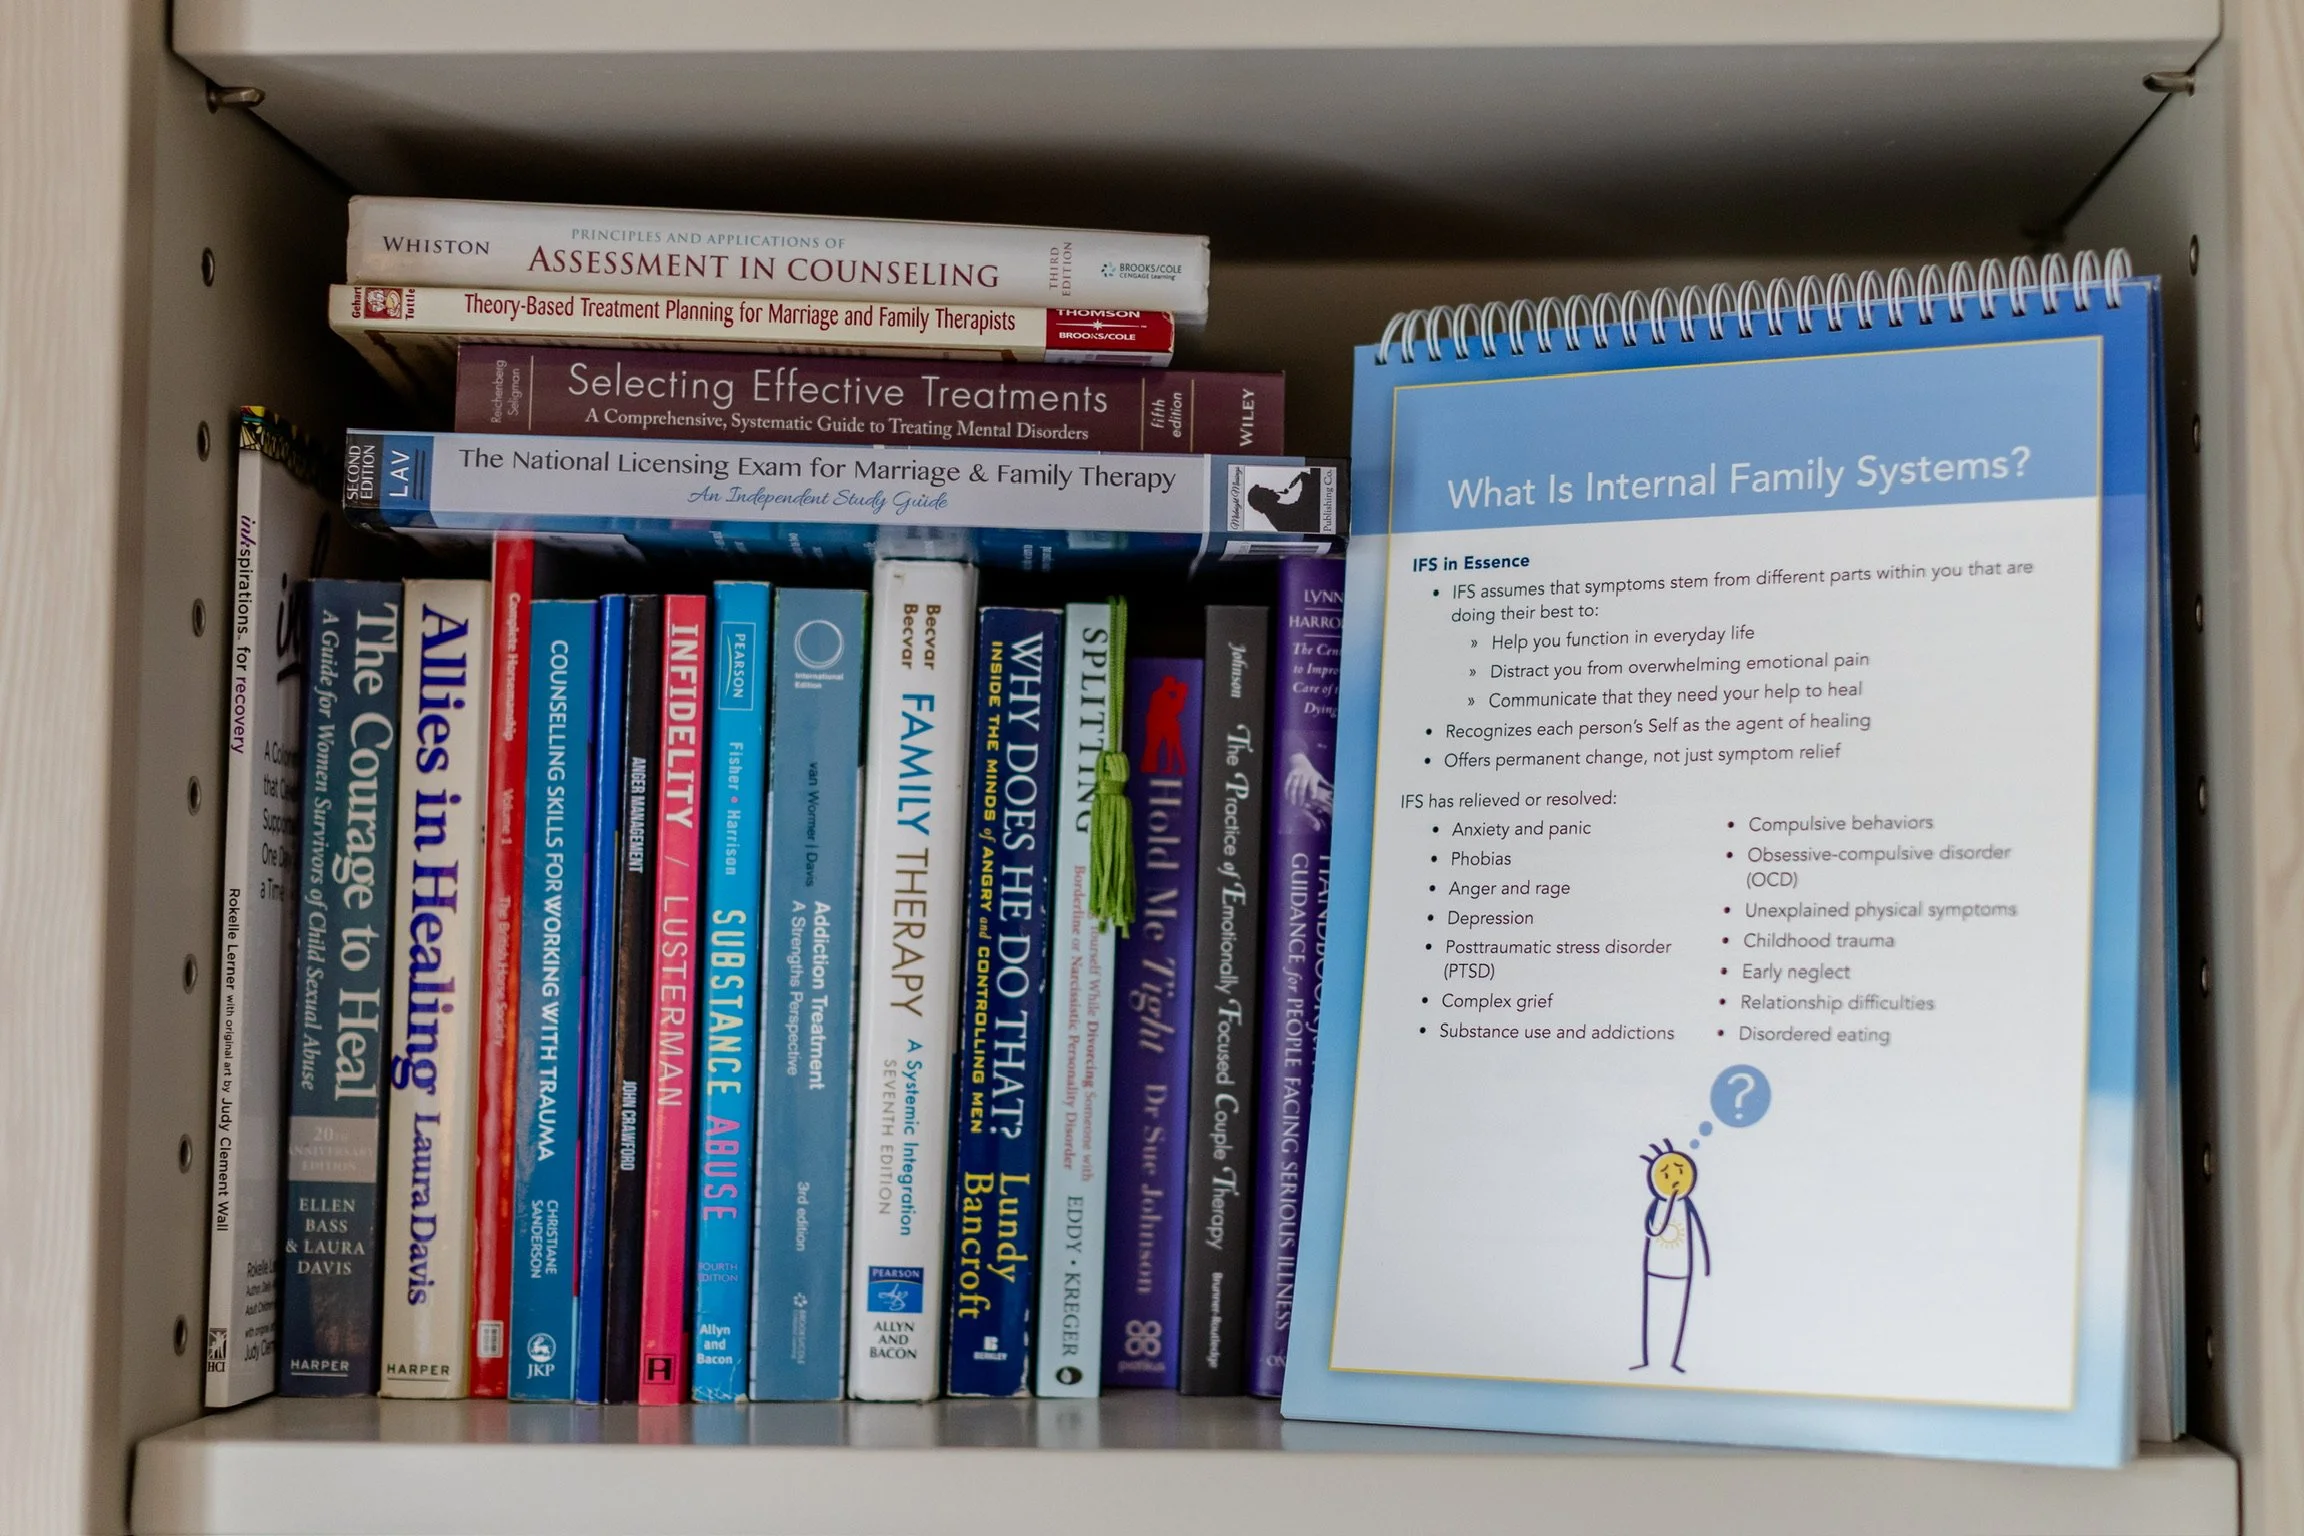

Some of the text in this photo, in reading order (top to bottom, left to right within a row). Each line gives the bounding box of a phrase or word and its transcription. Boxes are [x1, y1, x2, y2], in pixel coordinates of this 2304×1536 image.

[382, 235, 490, 256] WHISTON
[570, 227, 846, 250] PRINCIPLES AND APPLICATIONS OF
[527, 244, 999, 289] ASSESSMENT IN COUNSELING
[1048, 246, 1060, 290] THIRD
[1061, 241, 1073, 298] EDITION
[1118, 261, 1183, 275] BROOKS/COLE
[351, 286, 362, 319] Gehart
[405, 287, 417, 320] Tuttle
[463, 292, 1017, 337] Theory-Based Treatment Planning for Marriage and Family Therapists
[1057, 308, 1141, 319] THOMSON
[1058, 331, 1137, 342] BROOKS/COLE
[567, 360, 1109, 414] Selecting Effective Treatments
[584, 406, 1090, 441] A Comprehensive, Systematic Guide to Treating Mental Disorders
[1149, 398, 1166, 430] fifth
[1171, 391, 1183, 439] edition
[1238, 387, 1256, 448] WILEY
[347, 444, 362, 500] SECOND
[361, 444, 376, 500] EDITION
[388, 449, 411, 498] LAV
[457, 446, 1177, 495] The National Licensing Exam for Marriage & Family Therapy
[1446, 444, 2032, 510] What Is Internal Family Systems?
[686, 484, 949, 517] An Independent Study Guide
[1322, 468, 1334, 533] Publishing Co.
[1412, 554, 1531, 573] IFS in Essence
[235, 645, 252, 672] for
[901, 602, 920, 670] Becvar
[923, 603, 942, 671] Becvar
[1491, 623, 1756, 655] Help you function in everyday life
[732, 632, 747, 699] PEARSON
[229, 676, 247, 755] recovery
[666, 621, 699, 828] INFIDELITY
[1443, 741, 1842, 773] Offers permanent change, not just symptom relief
[628, 755, 647, 874] ANGER MANAGEMENT
[724, 741, 745, 877] Fisher Harrison
[1400, 788, 1618, 810] IFS has relieved or resolved:
[332, 601, 399, 1102] The Courage to Heal
[391, 602, 470, 1096] Allies in Healing
[1450, 819, 1592, 841] Anxiety and panic
[889, 692, 936, 1018] FAMILY THERAPY
[1450, 849, 1513, 867] Phobias
[536, 638, 570, 1163] COUNSELLING SKILLS FOR WORKING WITH TRAUMA
[989, 630, 1045, 1140] WHY DOES HE DO THAT?
[1447, 909, 1535, 931] Depression
[1742, 931, 1896, 949] Childhood trauma
[1445, 937, 1673, 955] Posttraumatic stress disorder
[808, 900, 832, 1091] Addiction Treatment
[1204, 723, 1255, 1251] The Practice of Emotionally Focused Couple Therapy
[1443, 962, 1496, 982] (PTSD)
[1741, 962, 1851, 985] Early neglect
[657, 895, 689, 1107] LUSTERMAN
[1441, 991, 1555, 1014] Complex grief
[704, 909, 747, 1221] SUBSTANCE ABUSE
[619, 1079, 638, 1172] JOHN CRAWFORD
[896, 1038, 924, 1237] A Systemic Integration
[406, 1111, 440, 1306] Laura Davis
[986, 1171, 1032, 1284] Lundy
[529, 1199, 544, 1280] SANDERSON
[545, 1199, 559, 1276] CHRISTIANE
[957, 1171, 996, 1320] Bancroft
[1061, 1195, 1084, 1357] EDDY KREGER
[290, 1359, 350, 1372] HARPER
[386, 1363, 450, 1377] HARPER
[526, 1362, 556, 1380] JKP
